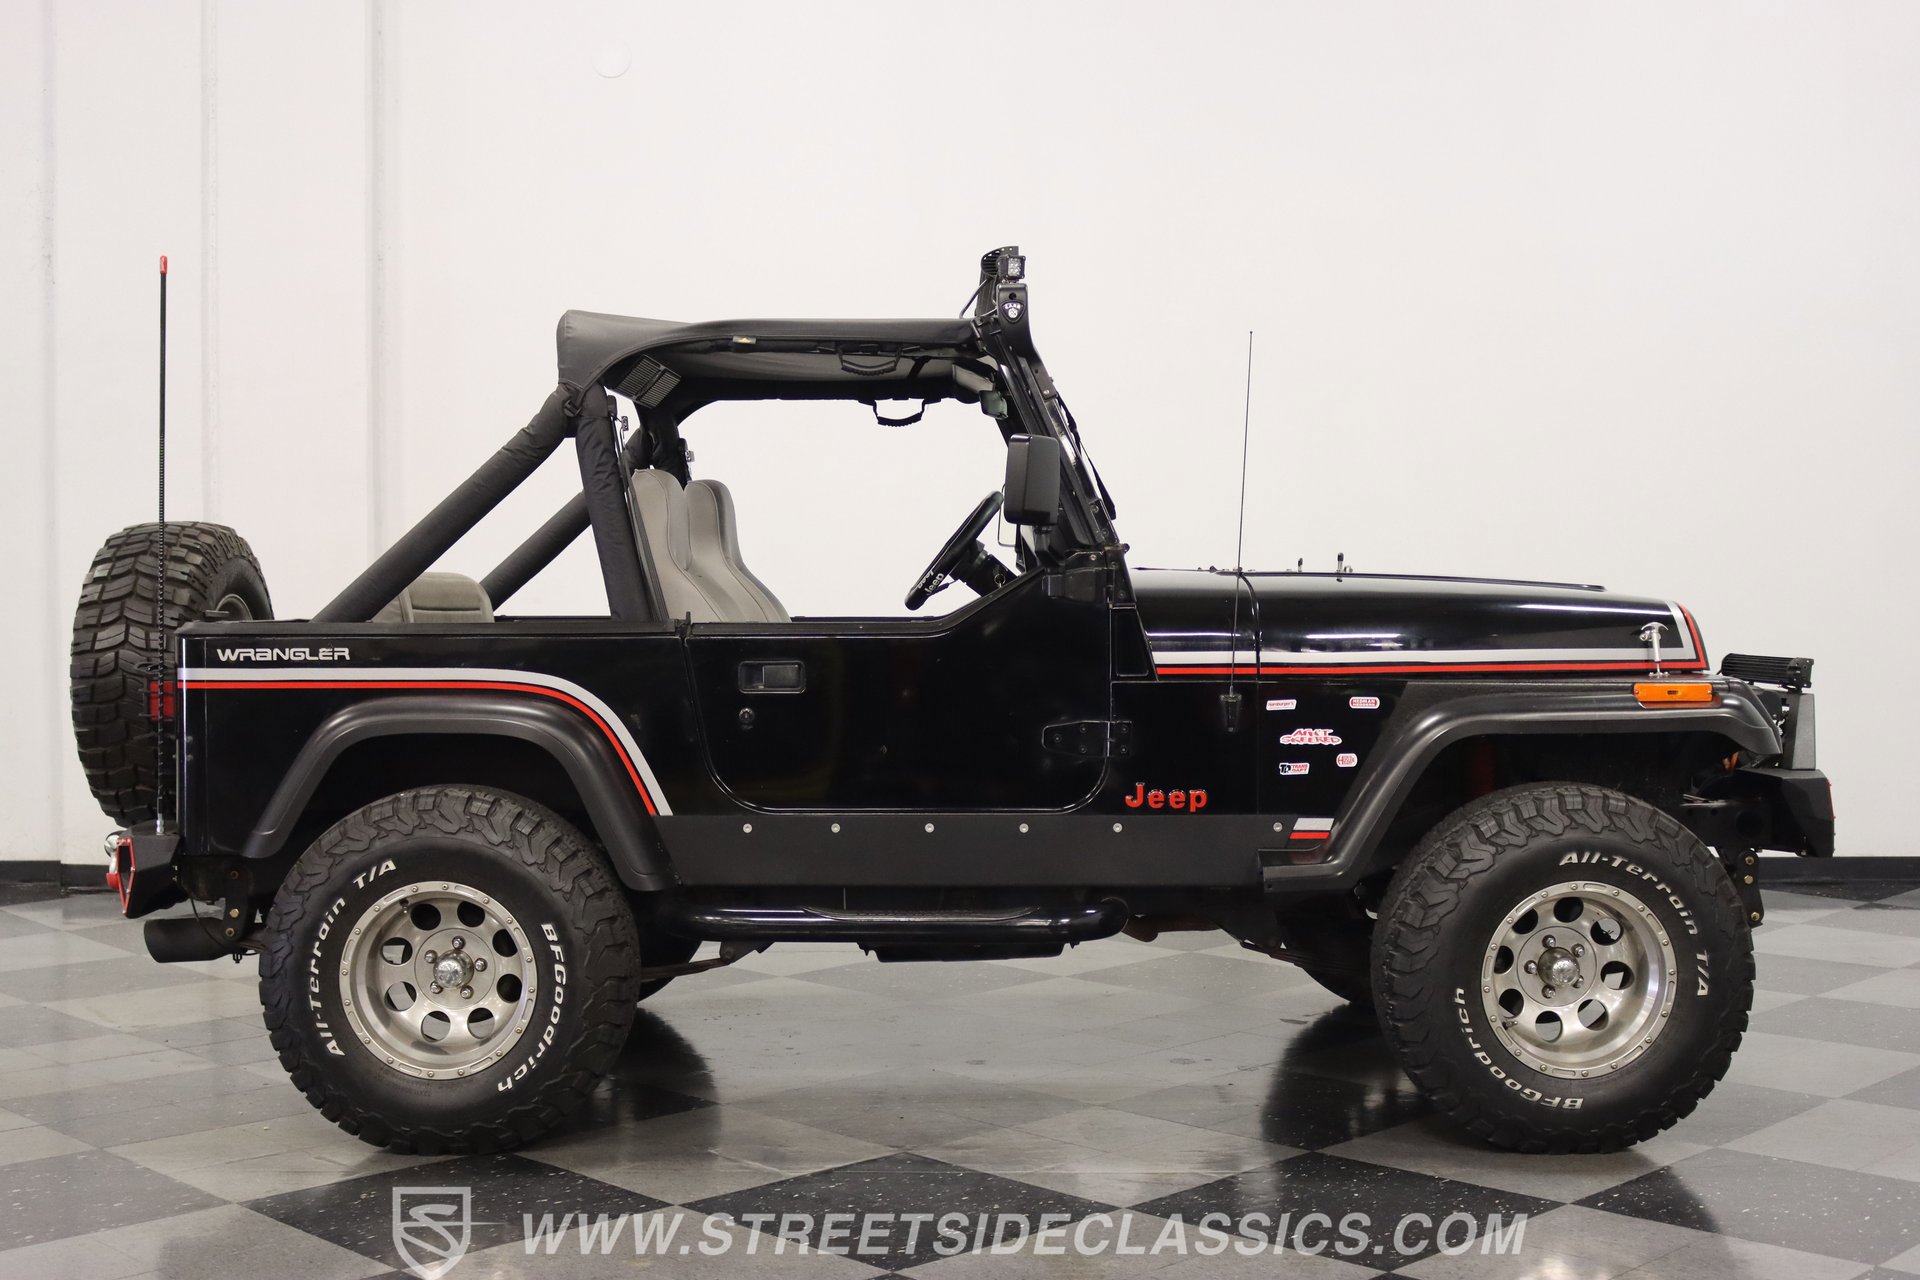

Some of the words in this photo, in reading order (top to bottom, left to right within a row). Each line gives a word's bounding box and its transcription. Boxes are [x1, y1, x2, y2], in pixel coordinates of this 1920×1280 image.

[1125, 782, 1208, 812] Jeep
[309, 898, 346, 1057] All-Terrain
[352, 859, 397, 890] T/A
[1559, 850, 1698, 935] All-Terrain
[1695, 949, 1710, 997] T/A
[497, 922, 567, 1093] BFGoodrich
[1454, 987, 1584, 1109] BFGoodrich
